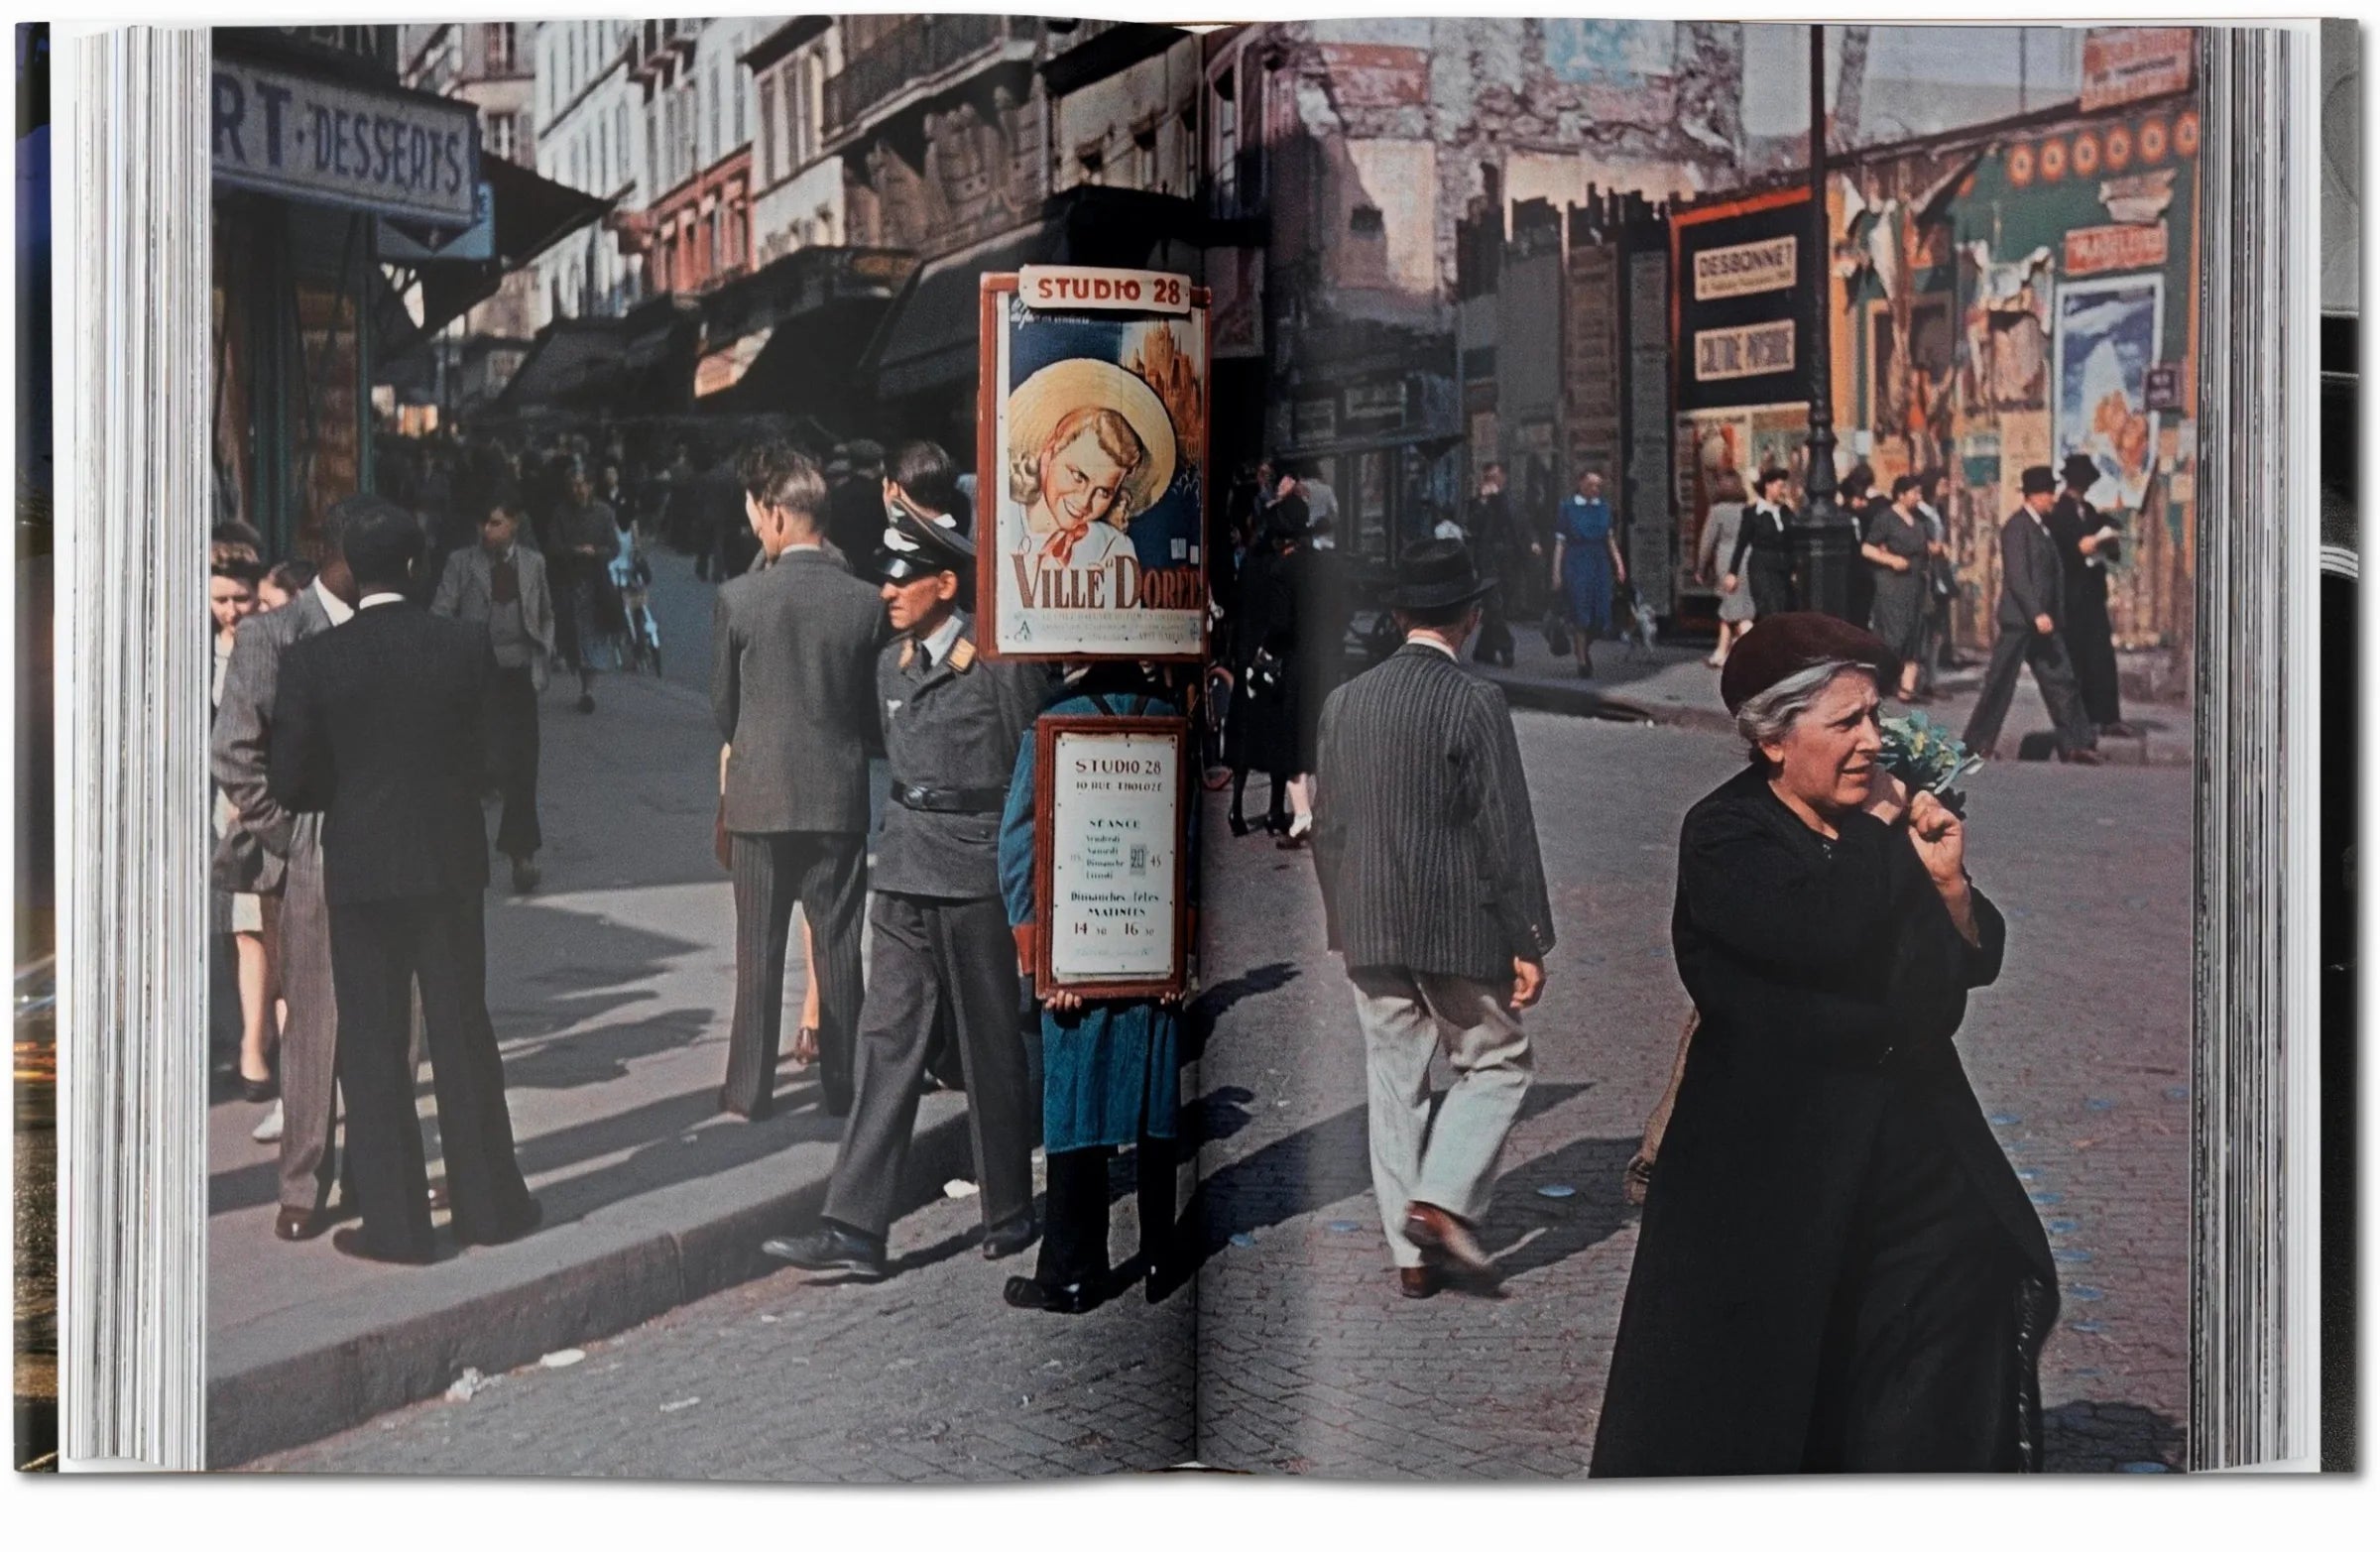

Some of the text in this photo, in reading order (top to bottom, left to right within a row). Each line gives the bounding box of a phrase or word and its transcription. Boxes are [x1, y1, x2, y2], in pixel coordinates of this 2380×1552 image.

[1037, 278, 1180, 305] STUDIO 28
[1076, 760, 1161, 775] STUDIO 28
[1092, 781, 1110, 790] RUE
[1150, 855, 1161, 869] 45
[1075, 922, 1087, 935] 14
[1126, 922, 1139, 936] 16
